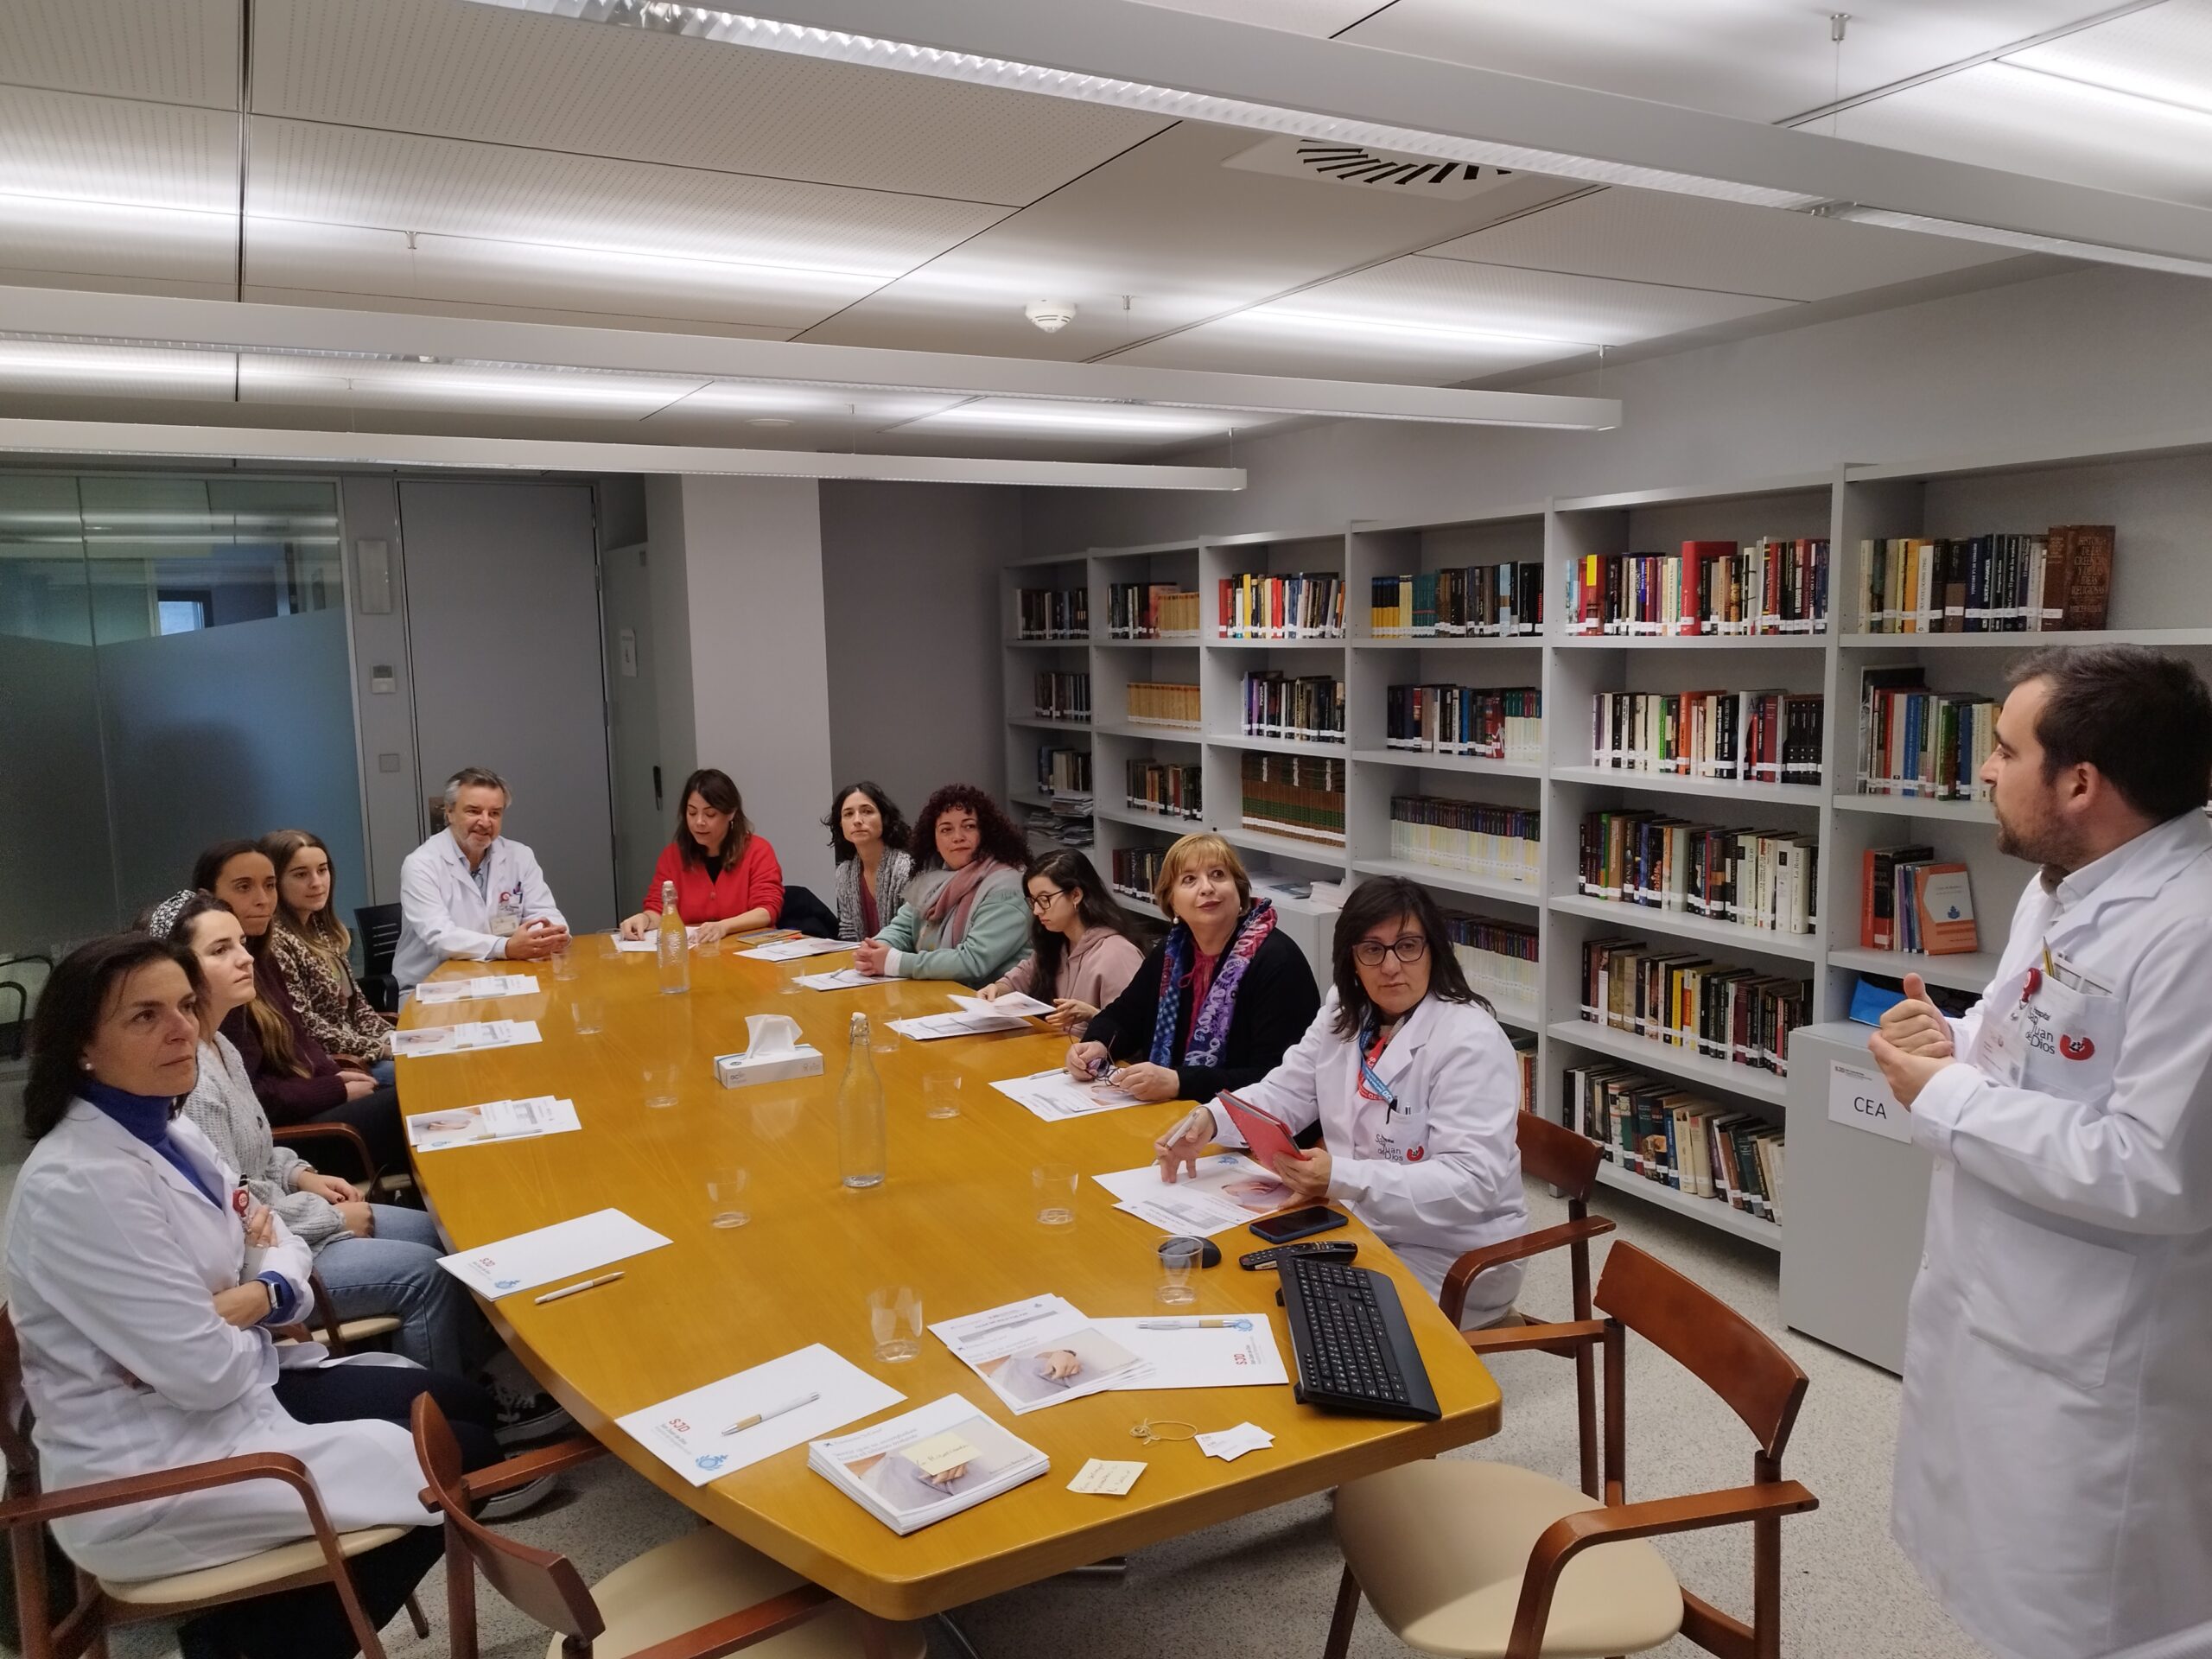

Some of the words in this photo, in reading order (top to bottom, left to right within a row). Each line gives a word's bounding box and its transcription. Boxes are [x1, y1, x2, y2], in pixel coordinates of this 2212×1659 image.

[2031, 1024, 2054, 1043] Juan
[2031, 1033, 2055, 1054] Dios
[1854, 1096, 1886, 1119] CEA
[1384, 1151, 1403, 1161] Dios
[669, 1418, 691, 1433] SJD
